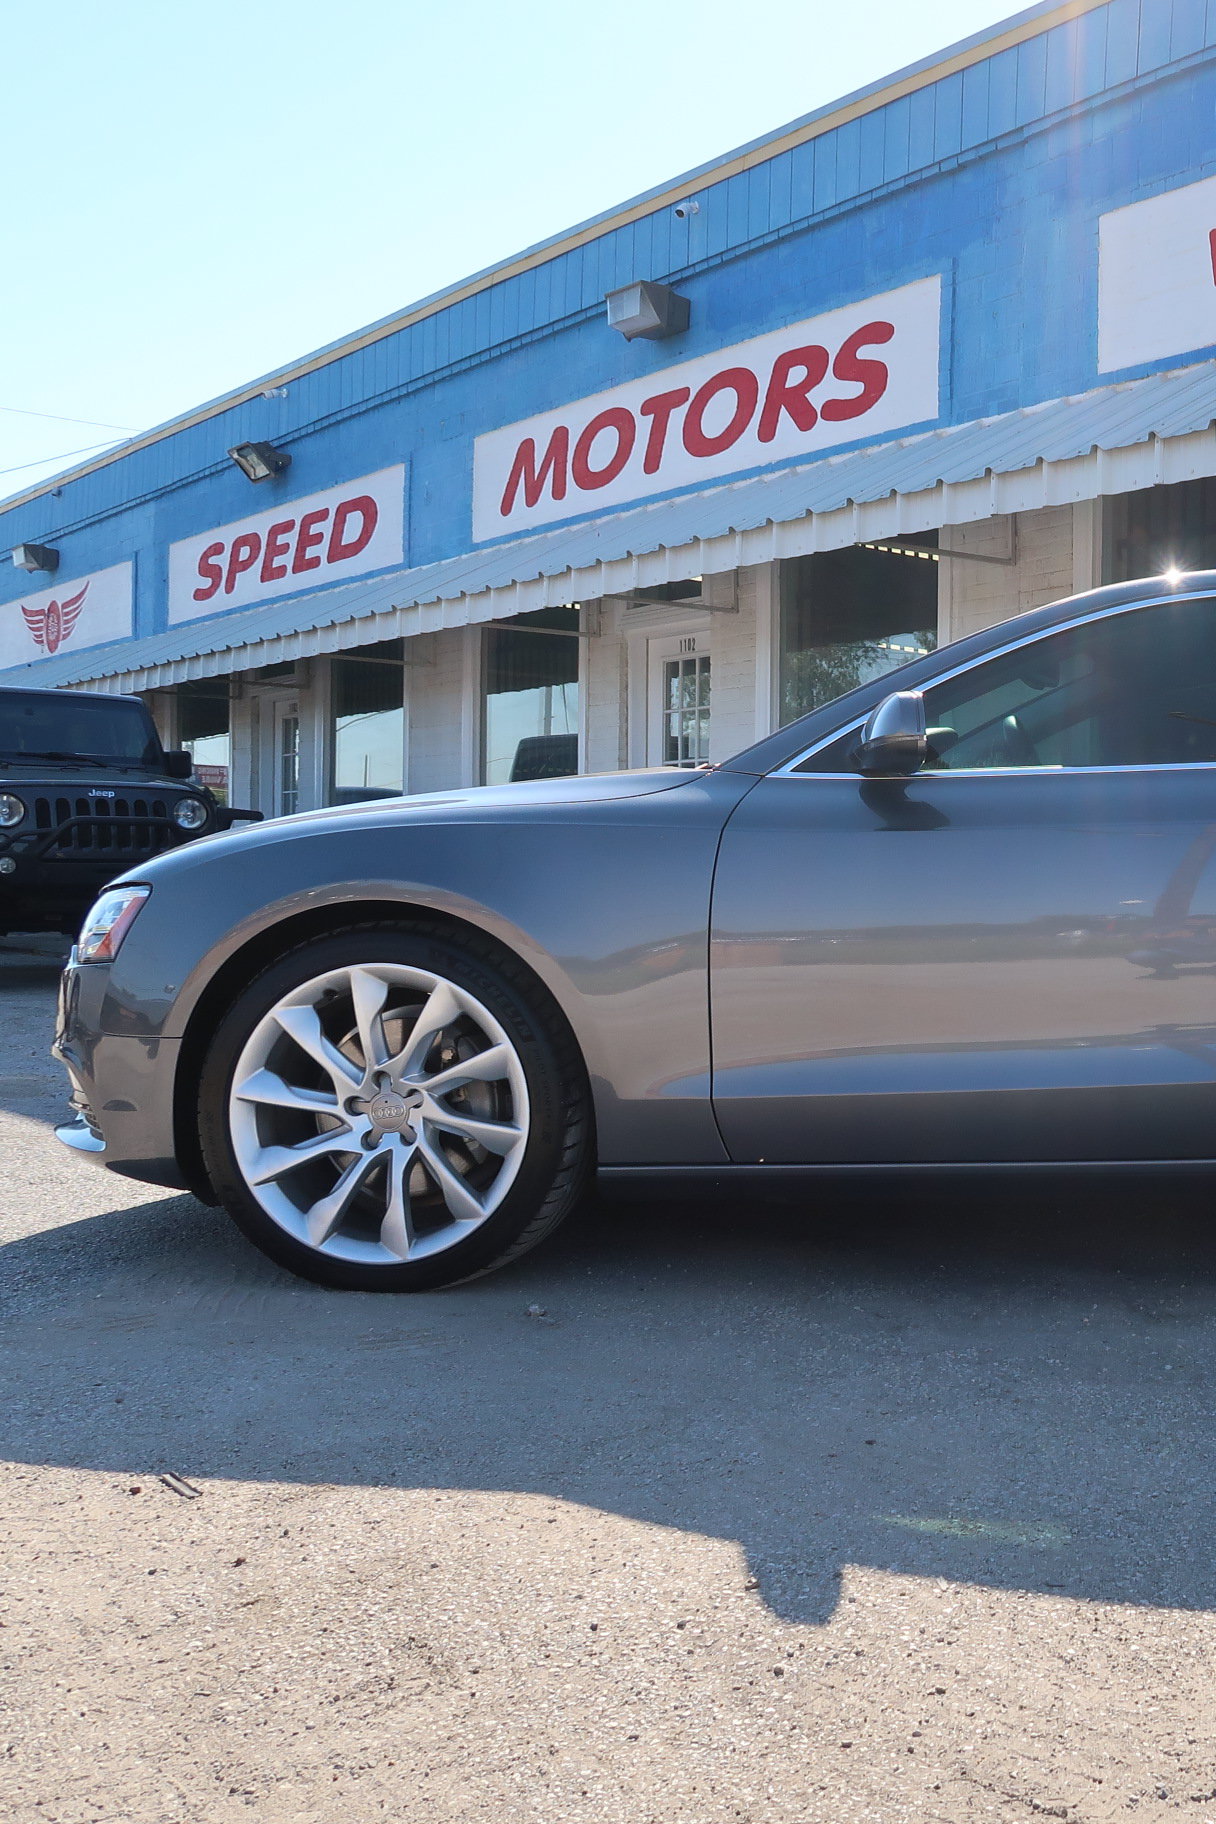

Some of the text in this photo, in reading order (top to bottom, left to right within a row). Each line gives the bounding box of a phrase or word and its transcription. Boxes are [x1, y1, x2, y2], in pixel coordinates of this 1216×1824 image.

[500, 321, 895, 517] MOTORS
[193, 495, 379, 601] SPEED
[679, 637, 696, 653] 1102
[88, 788, 116, 799] Jeep
